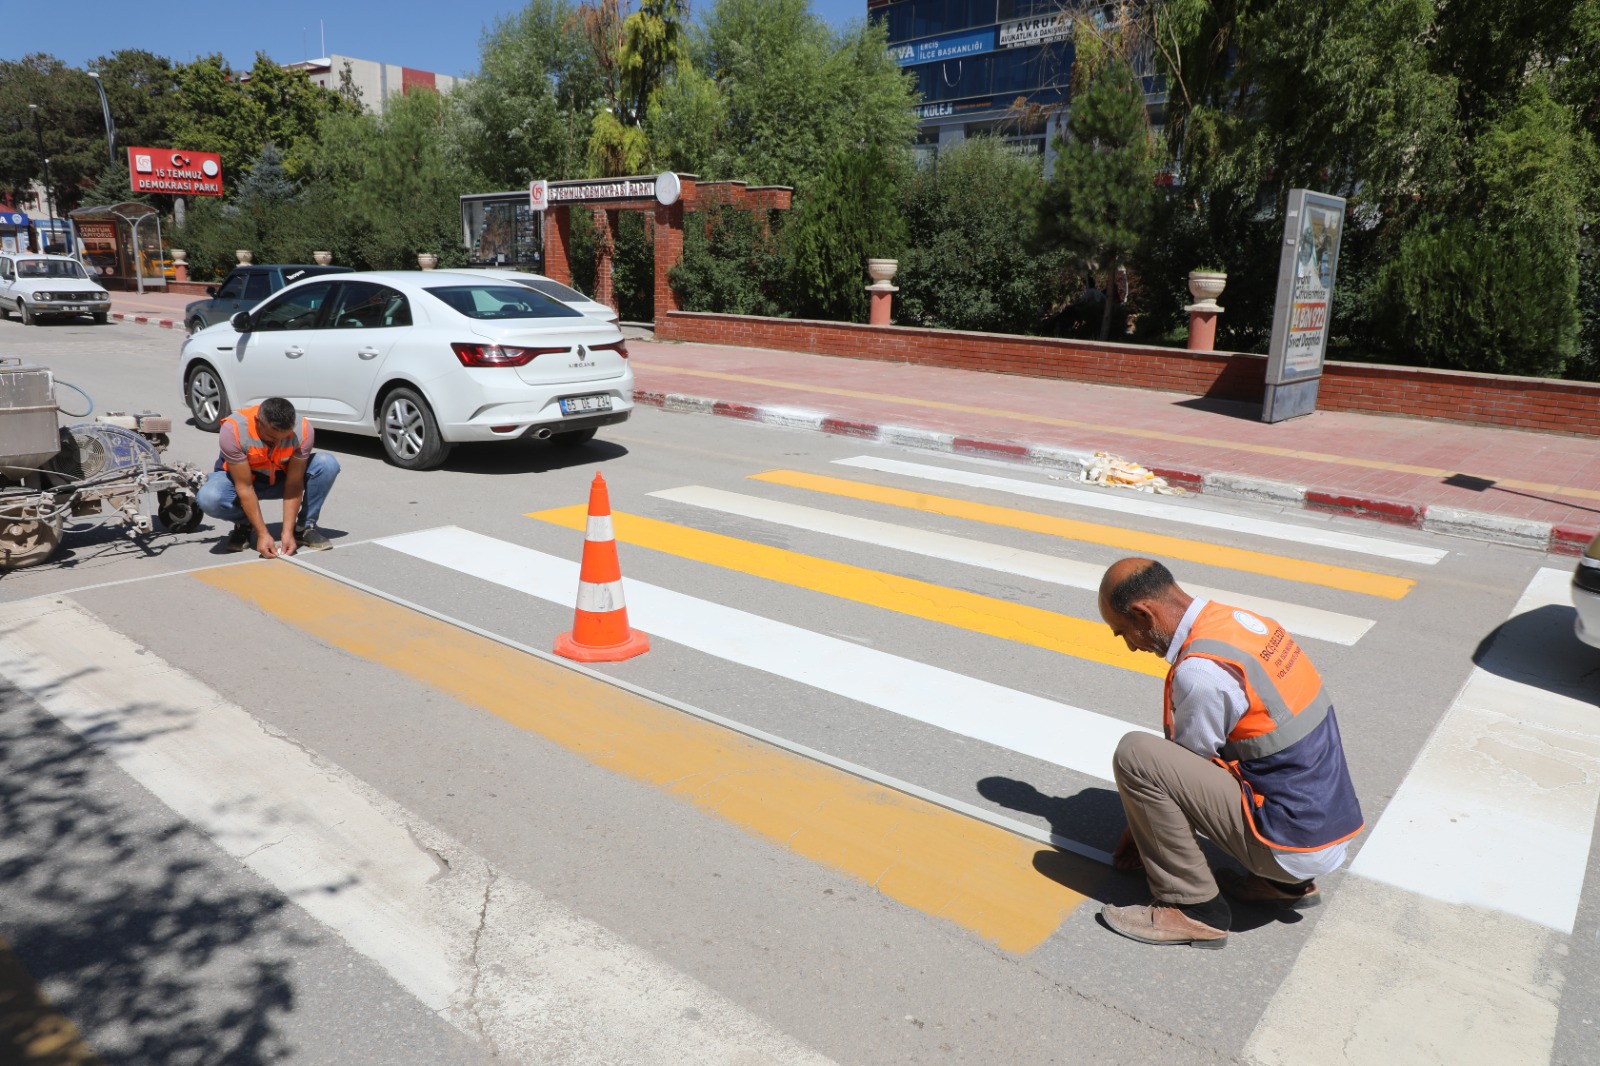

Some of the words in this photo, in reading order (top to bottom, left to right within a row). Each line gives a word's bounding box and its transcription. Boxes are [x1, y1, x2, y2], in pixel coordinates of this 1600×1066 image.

[1001, 30, 1032, 43] AVUKATLIK
[920, 40, 939, 51] ERCİŞ
[920, 48, 936, 60] İLÇE
[937, 41, 983, 57] BAŞKANLIĞI
[923, 103, 953, 117] KOLEJİ
[156, 168, 165, 177] 15
[167, 169, 203, 179] TEMMUZ
[139, 179, 192, 191] DEMOKRASİ
[194, 182, 218, 192] PARKI
[1312, 306, 1325, 327] 922
[1259, 643, 1279, 662] ERCİŞ
[1277, 668, 1288, 680] YOL
